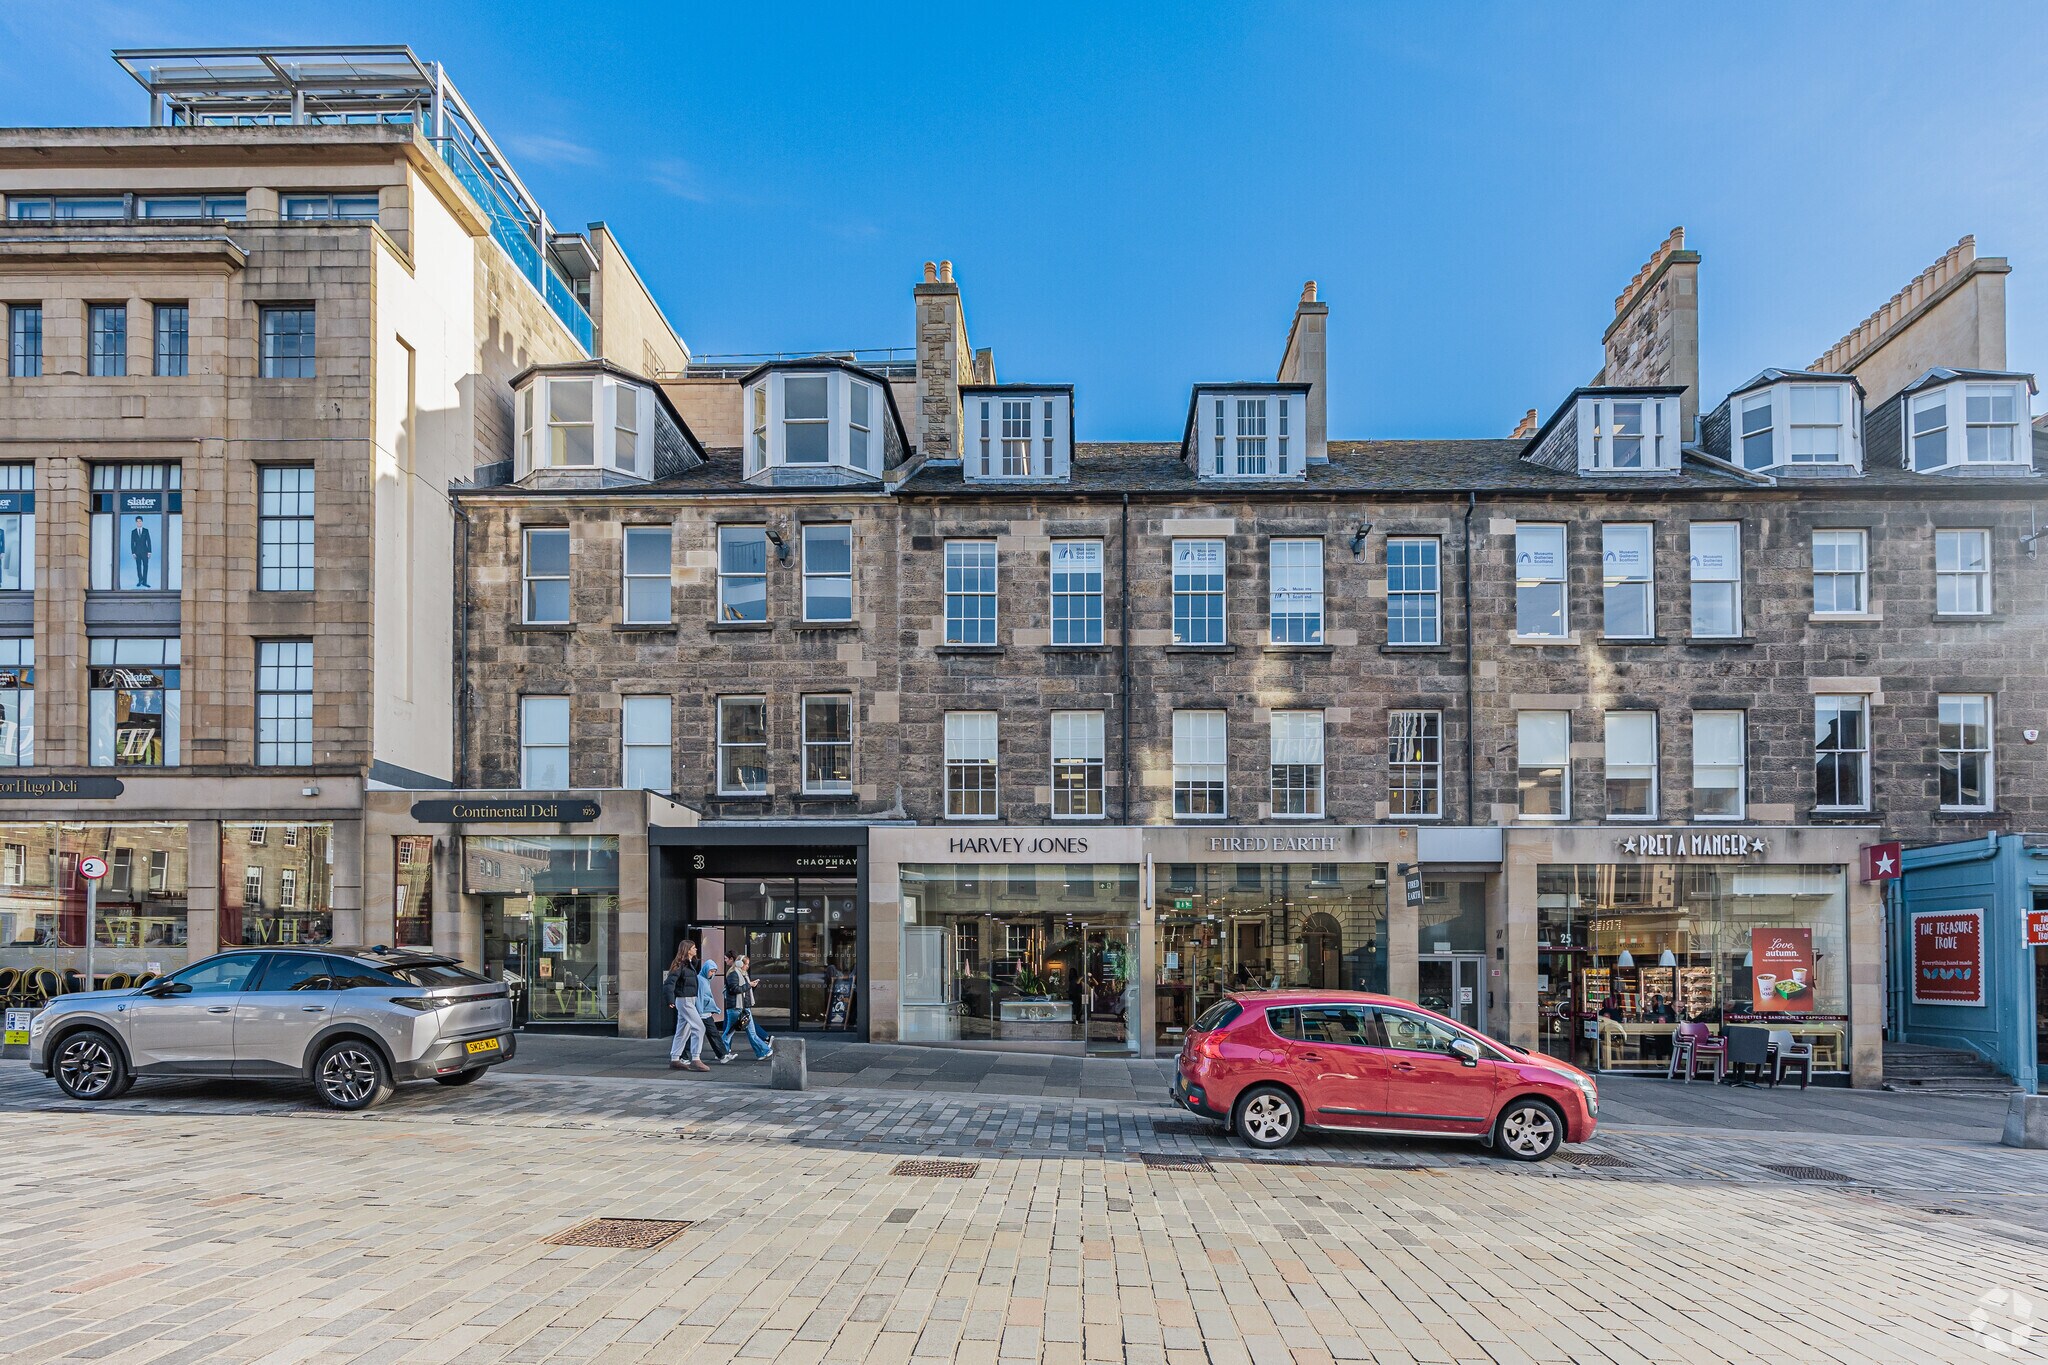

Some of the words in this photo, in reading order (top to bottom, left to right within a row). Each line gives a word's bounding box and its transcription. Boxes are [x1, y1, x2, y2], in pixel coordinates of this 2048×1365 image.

[127, 496, 156, 506] slater
[16, 780, 50, 796] Hugo
[52, 780, 77, 792] Deli
[452, 804, 526, 818] Continental
[531, 804, 558, 817] Deli
[582, 808, 595, 816] 1955
[950, 837, 1024, 853] HARVEY
[1027, 837, 1088, 853] JONES
[1210, 837, 1269, 851] FIRED
[1272, 837, 1335, 851] EARTH
[1640, 834, 1673, 856] PRET
[1677, 834, 1687, 856] A
[1691, 834, 1748, 856] MANGER
[1407, 879, 1420, 889] FIRED
[1407, 890, 1422, 901] EARTH
[255, 918, 300, 943] VH
[1496, 929, 1503, 939] 27
[1920, 922, 1933, 935] THE
[1936, 921, 1973, 935] TREASURE
[1560, 933, 1572, 943] 25
[1768, 938, 1794, 950] Love,
[1935, 936, 1958, 949] TROVE
